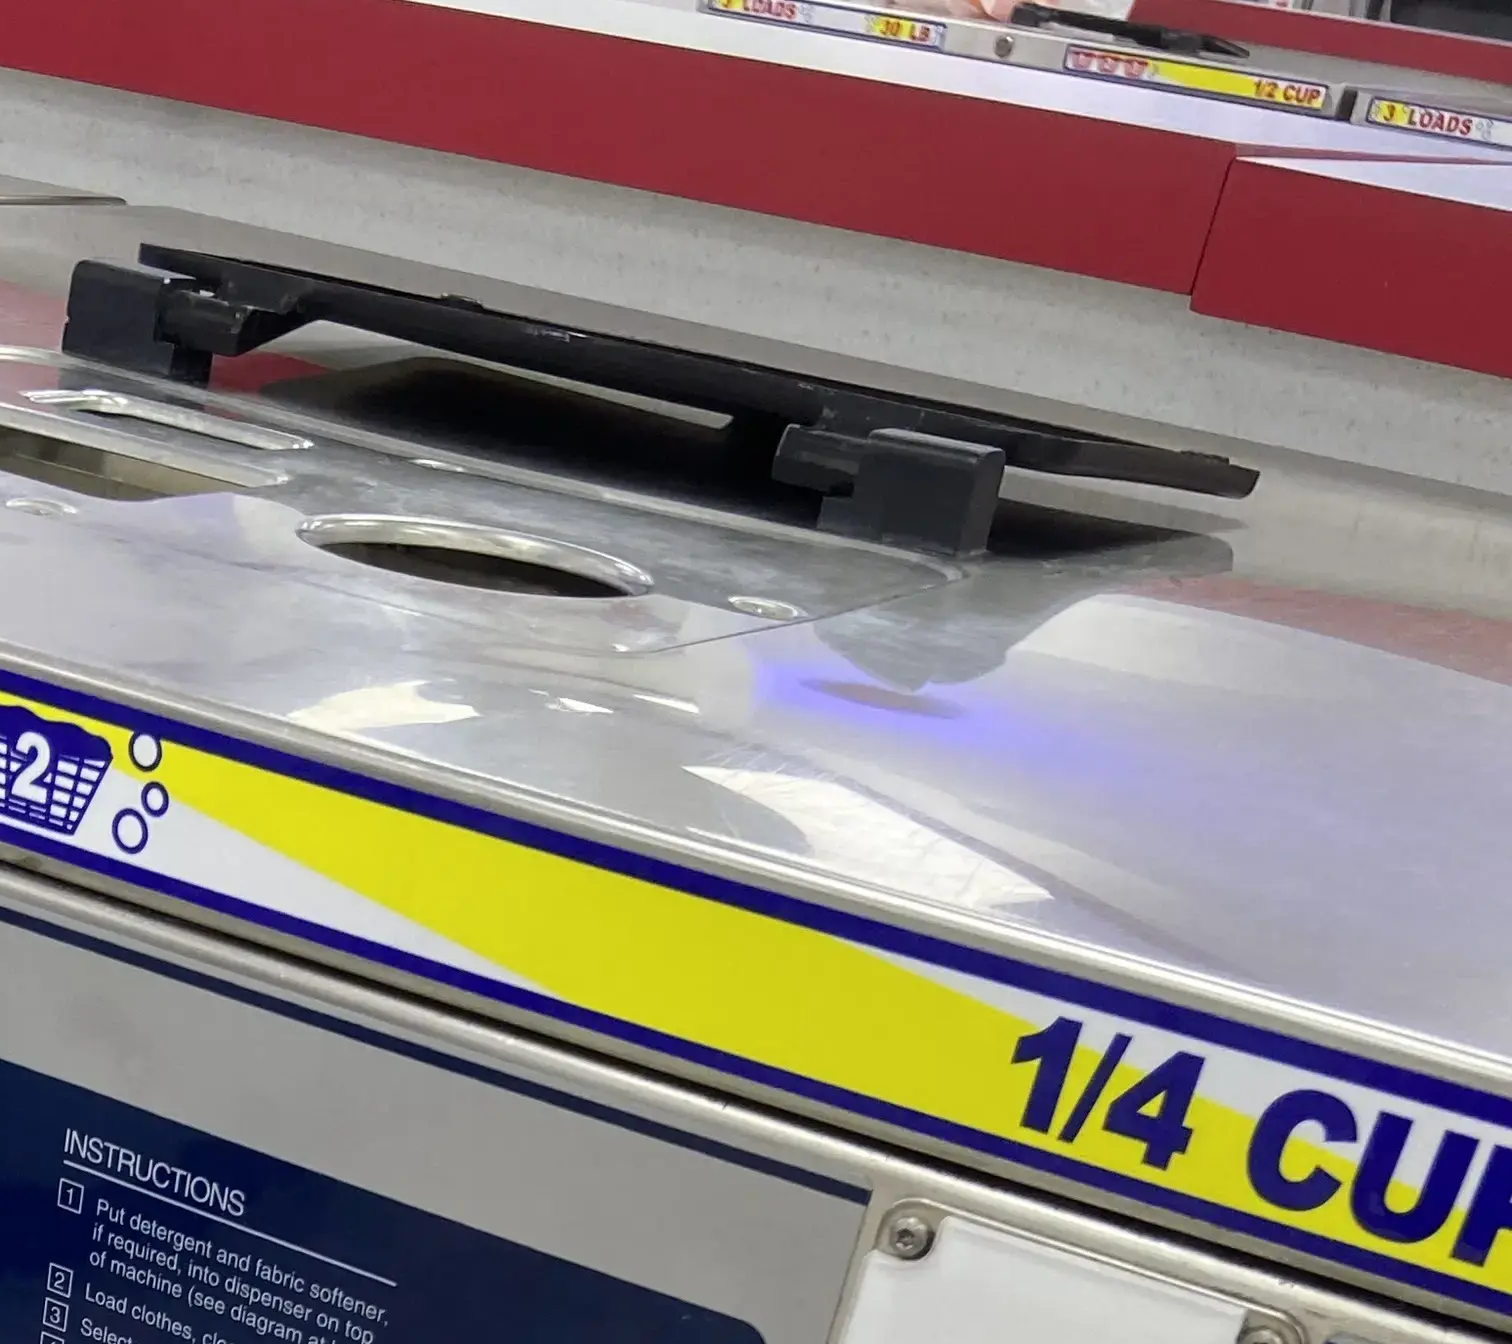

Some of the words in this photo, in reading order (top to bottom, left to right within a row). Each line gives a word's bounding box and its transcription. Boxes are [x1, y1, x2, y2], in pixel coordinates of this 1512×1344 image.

[1253, 78, 1278, 100] 1/2
[1282, 84, 1322, 107] CUP
[1406, 107, 1473, 136] LOADS
[11, 730, 53, 804] 2
[1010, 1015, 1206, 1172] 1/4
[63, 1127, 246, 1218] INSTRUCTIONS
[88, 1248, 108, 1268] of
[110, 1257, 183, 1299] machine
[187, 1285, 226, 1316] (see
[229, 1298, 303, 1344] diagram
[92, 1222, 105, 1243] if
[107, 1228, 182, 1277] required,
[187, 1260, 220, 1287] into
[224, 1271, 313, 1323] dispenser
[315, 1311, 340, 1334] on
[95, 1197, 127, 1226] Put
[128, 1210, 213, 1260] detergent
[216, 1243, 251, 1273] and
[255, 1257, 306, 1295] fabric
[308, 1281, 390, 1328] softener,
[84, 1281, 128, 1314] Load
[130, 1298, 197, 1344] clothes,
